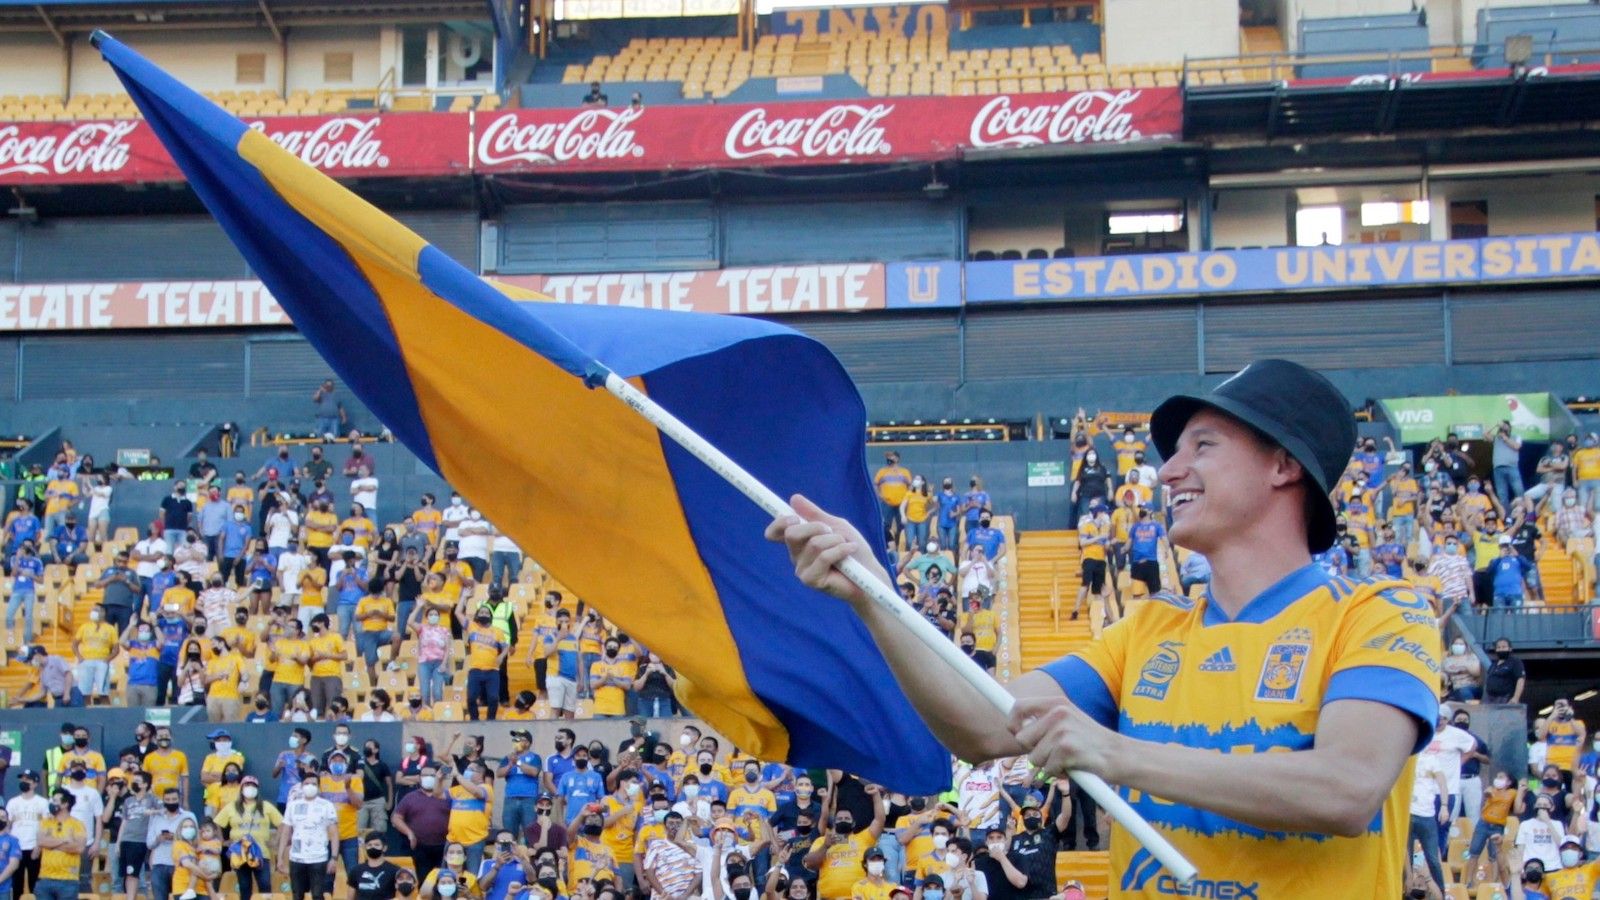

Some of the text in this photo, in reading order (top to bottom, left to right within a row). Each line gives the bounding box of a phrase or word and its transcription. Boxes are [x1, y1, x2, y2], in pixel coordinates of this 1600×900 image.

[477, 108, 645, 165] Coca-Cola
[724, 104, 896, 159] Coca-Cola
[969, 89, 1142, 148] Coca-Cola
[716, 265, 872, 314] TECATE
[905, 266, 941, 304] U
[1013, 235, 1600, 297] ESTADIO UNIVERSITA
[0, 284, 119, 330] ECATE
[1134, 685, 1164, 699] EXTRA
